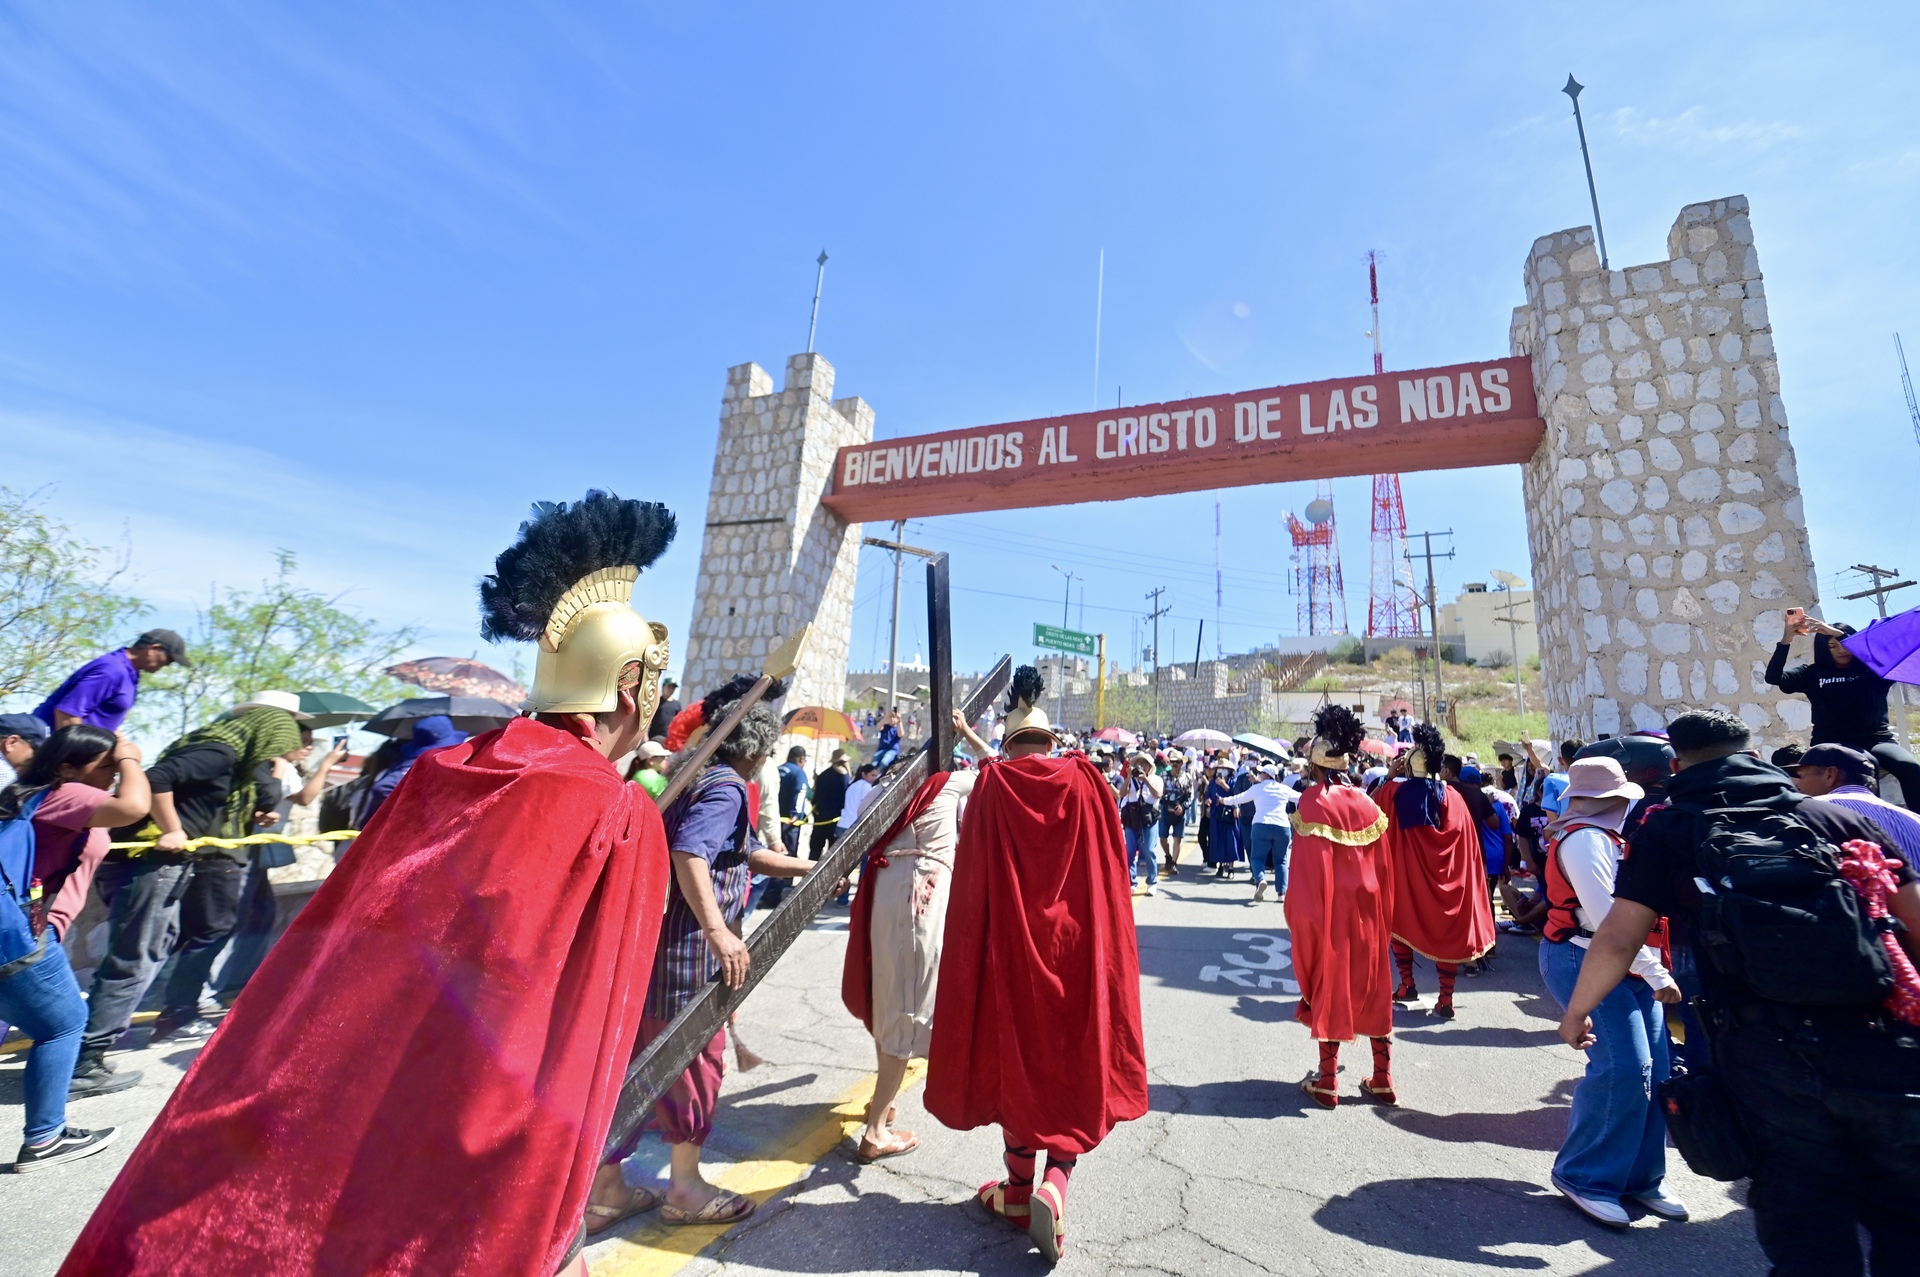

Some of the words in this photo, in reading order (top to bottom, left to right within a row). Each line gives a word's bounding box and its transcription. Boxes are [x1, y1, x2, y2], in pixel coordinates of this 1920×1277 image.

[843, 431, 1023, 487] BIENVENIDOS
[1038, 425, 1077, 465] AL
[1096, 407, 1217, 460] CRISTO
[1234, 397, 1281, 444] DE
[1300, 385, 1379, 436] LAS
[1398, 368, 1512, 424] NOAS
[1045, 638, 1062, 646] PUERTO
